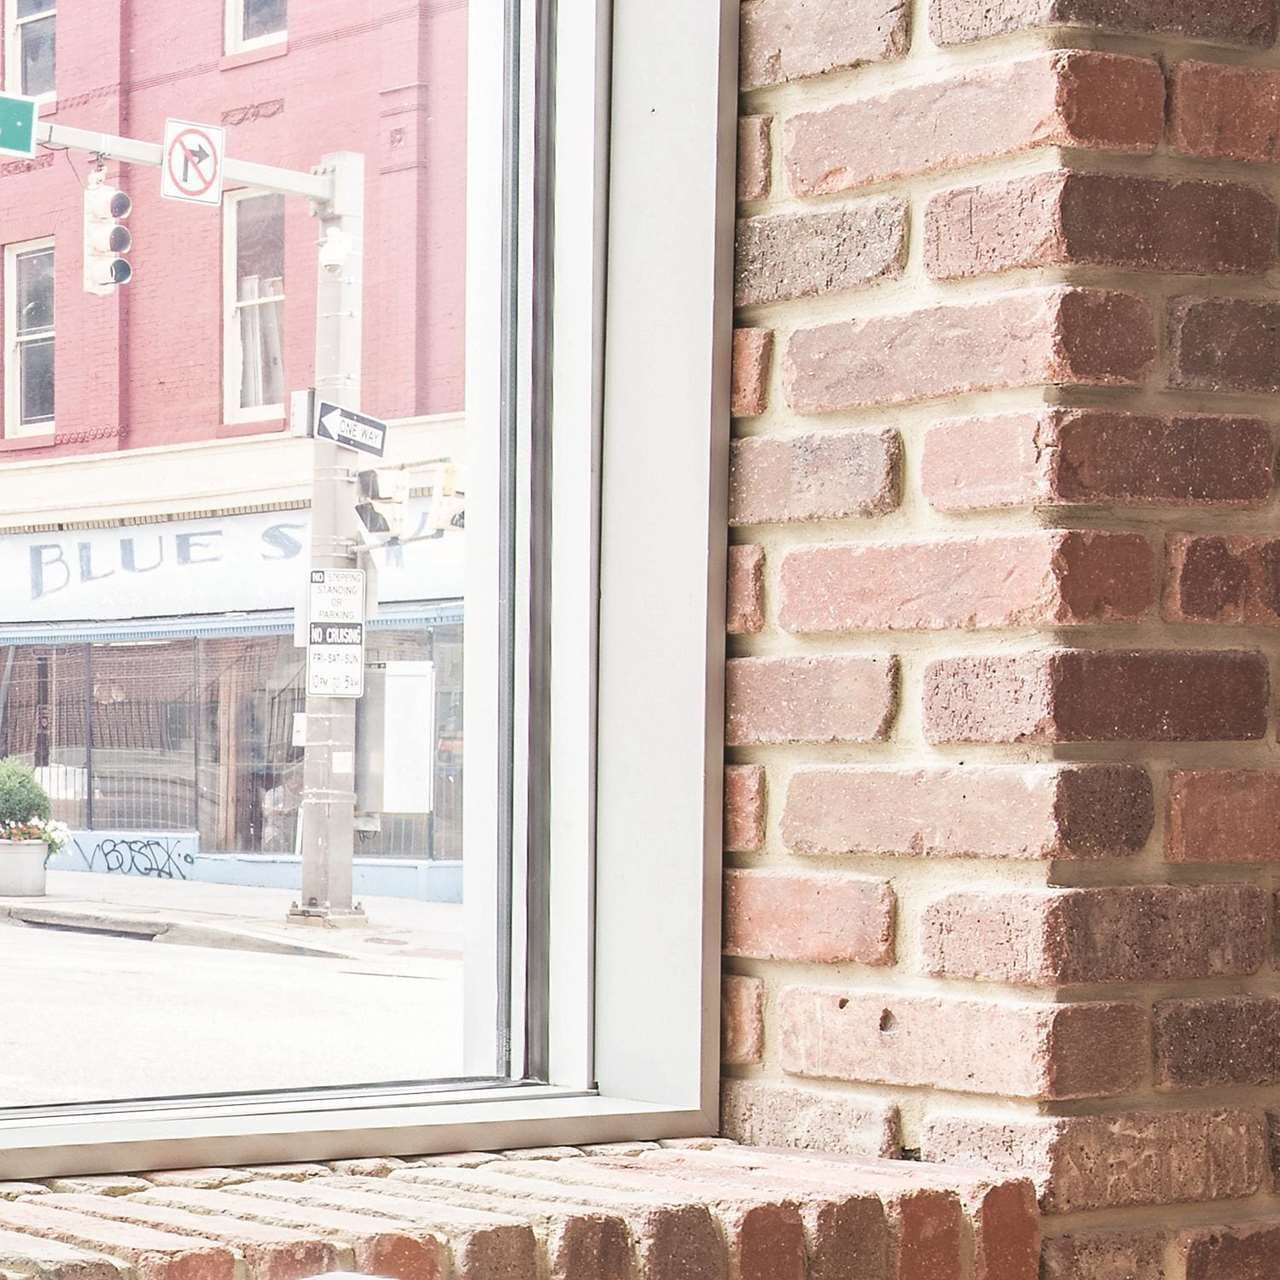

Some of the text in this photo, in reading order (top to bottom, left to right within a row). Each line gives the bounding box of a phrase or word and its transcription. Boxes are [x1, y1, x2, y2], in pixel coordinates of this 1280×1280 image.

[340, 419, 380, 442] ONE WAY
[29, 529, 224, 600] BLUE
[312, 572, 323, 582] NO
[318, 585, 358, 596] STANDING
[330, 598, 342, 606] OR
[319, 609, 355, 619] PARKING
[311, 627, 362, 643] NO CRUISING
